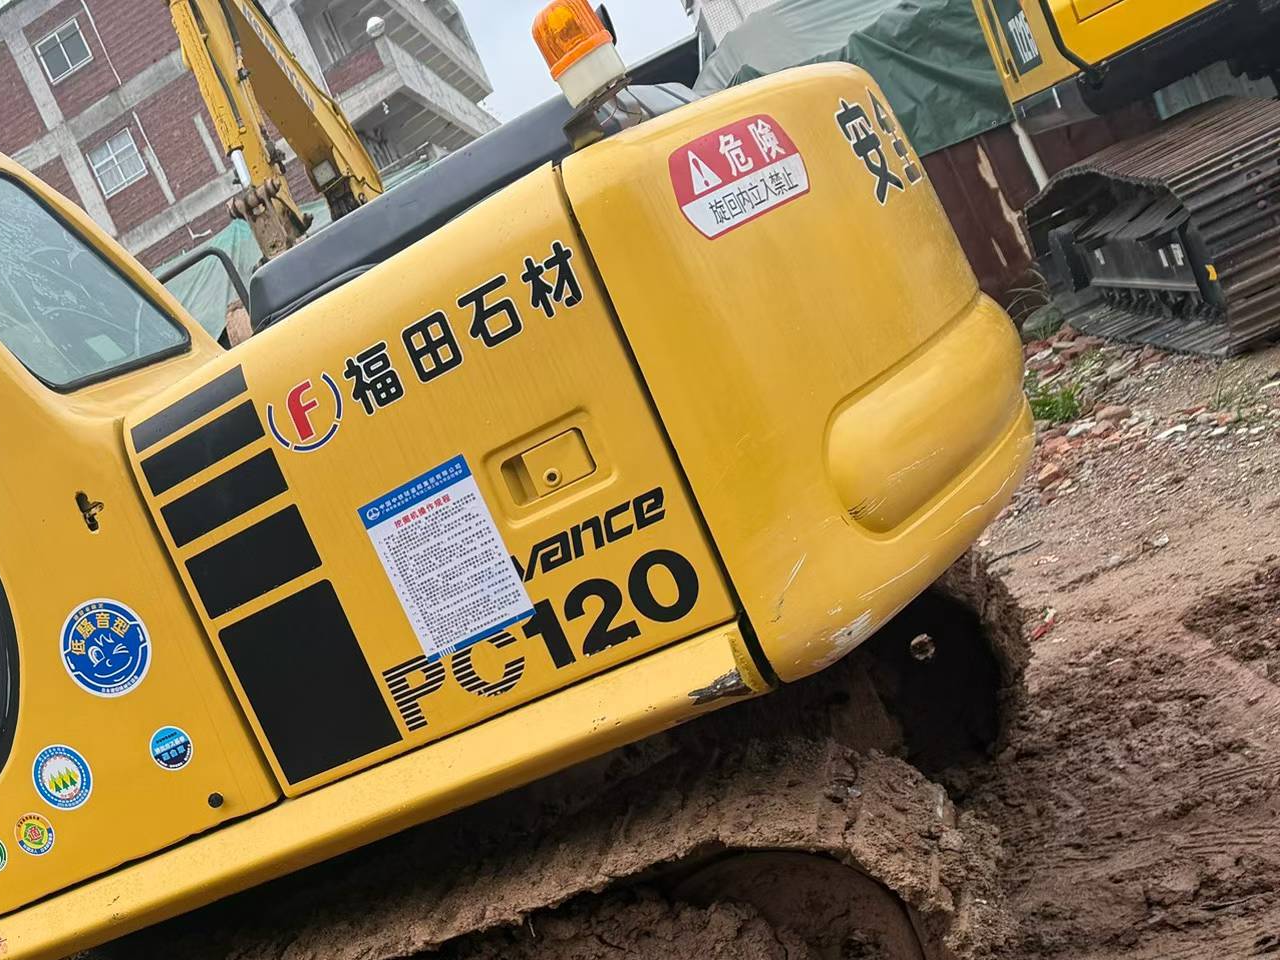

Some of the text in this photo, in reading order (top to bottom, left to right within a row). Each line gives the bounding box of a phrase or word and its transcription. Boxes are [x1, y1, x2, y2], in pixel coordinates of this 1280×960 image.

[708, 167, 800, 225] 旋回内立入禁止
[343, 239, 584, 416] 福田石材
[71, 612, 130, 655] 低騒音型
[382, 548, 700, 732] PC120
